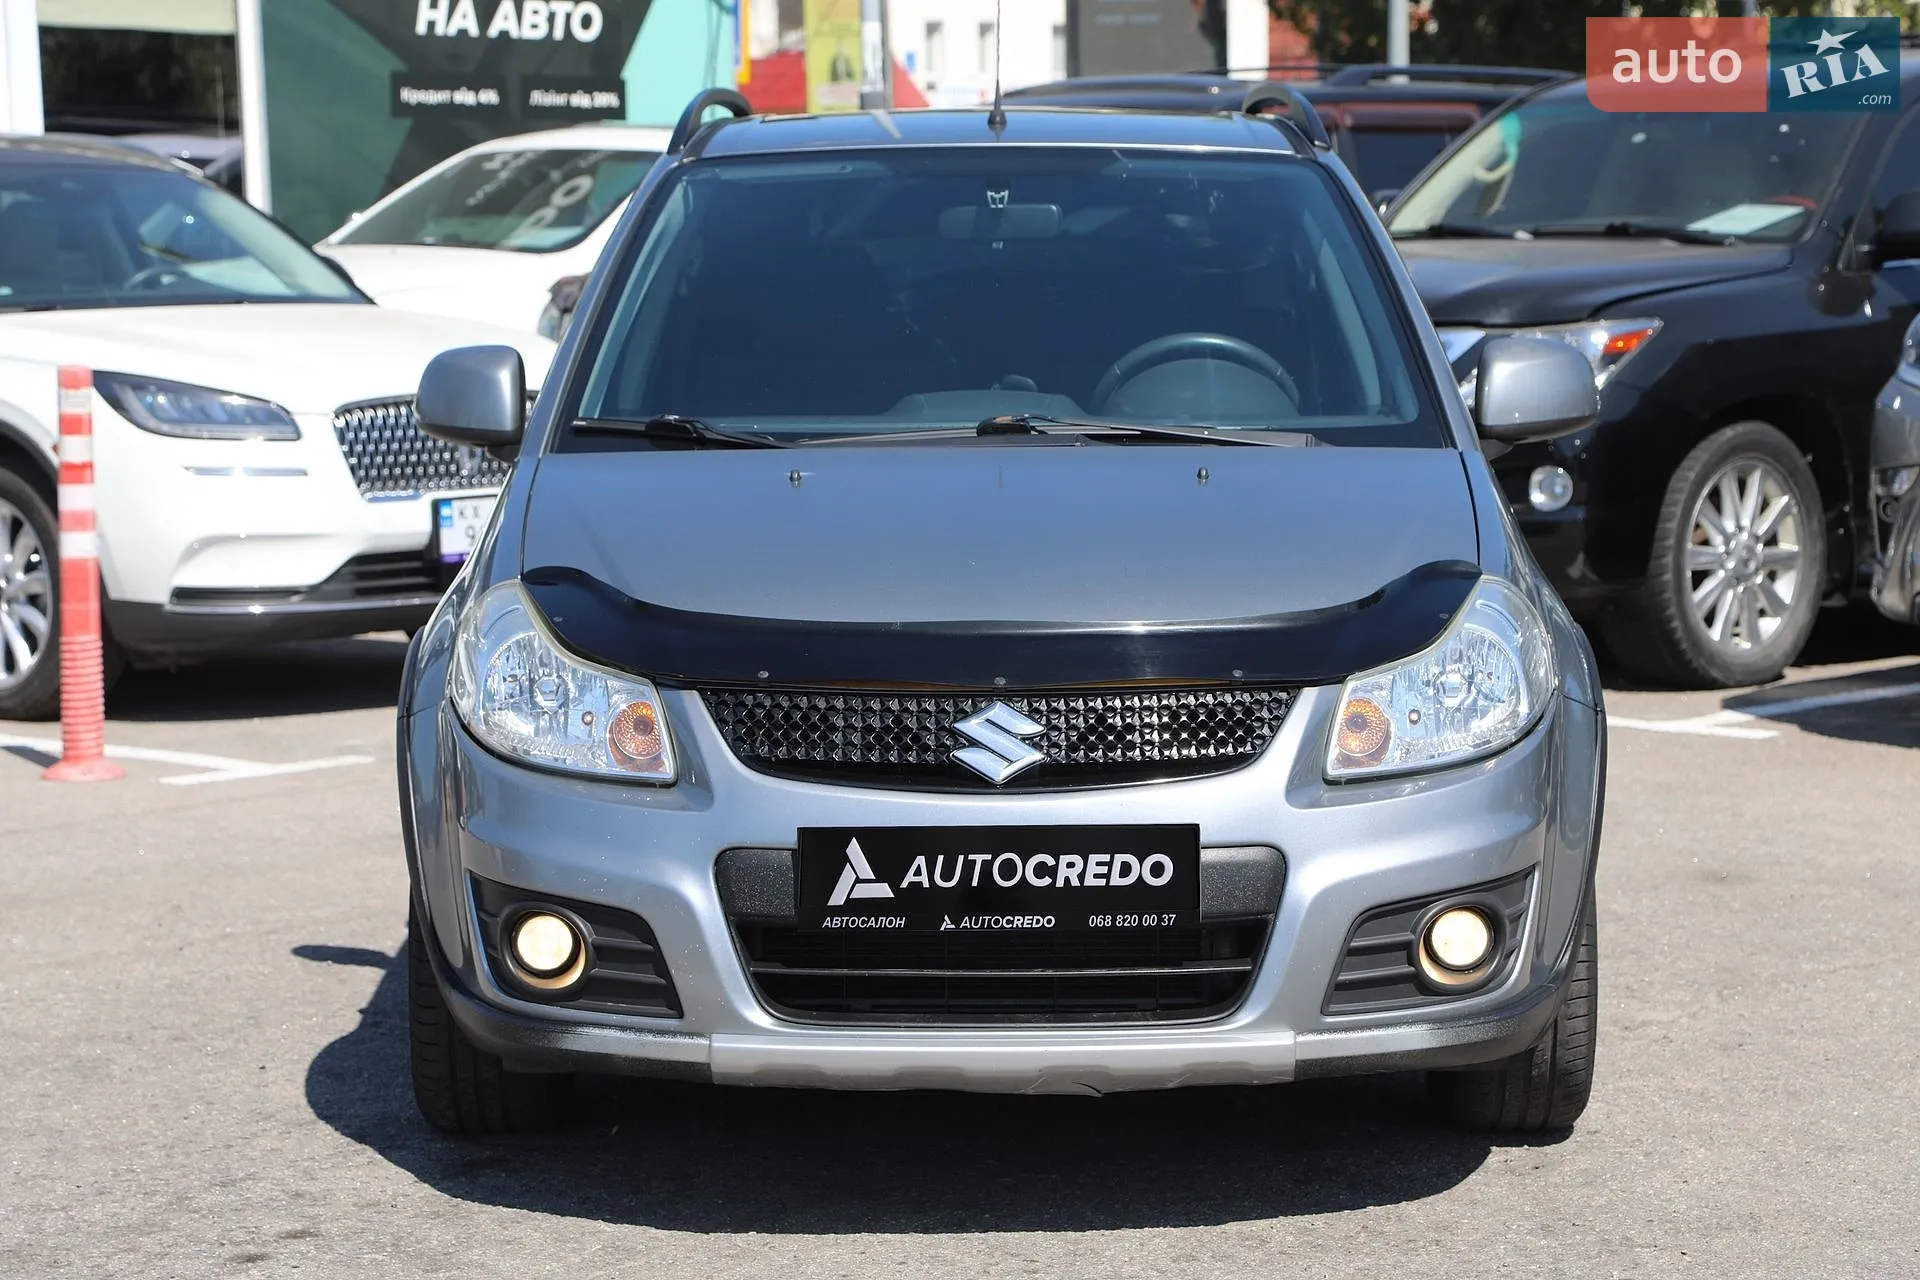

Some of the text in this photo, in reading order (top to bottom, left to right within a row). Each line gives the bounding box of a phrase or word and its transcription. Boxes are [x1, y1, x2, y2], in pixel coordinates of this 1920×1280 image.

[414, 0, 604, 43] НА АВТО
[900, 852, 1174, 888] AUTOCREDO
[822, 916, 906, 929] АВТОСАЛОН
[960, 915, 1055, 929] AUTOCREDO
[1088, 914, 1177, 928] 068 820 00 37
